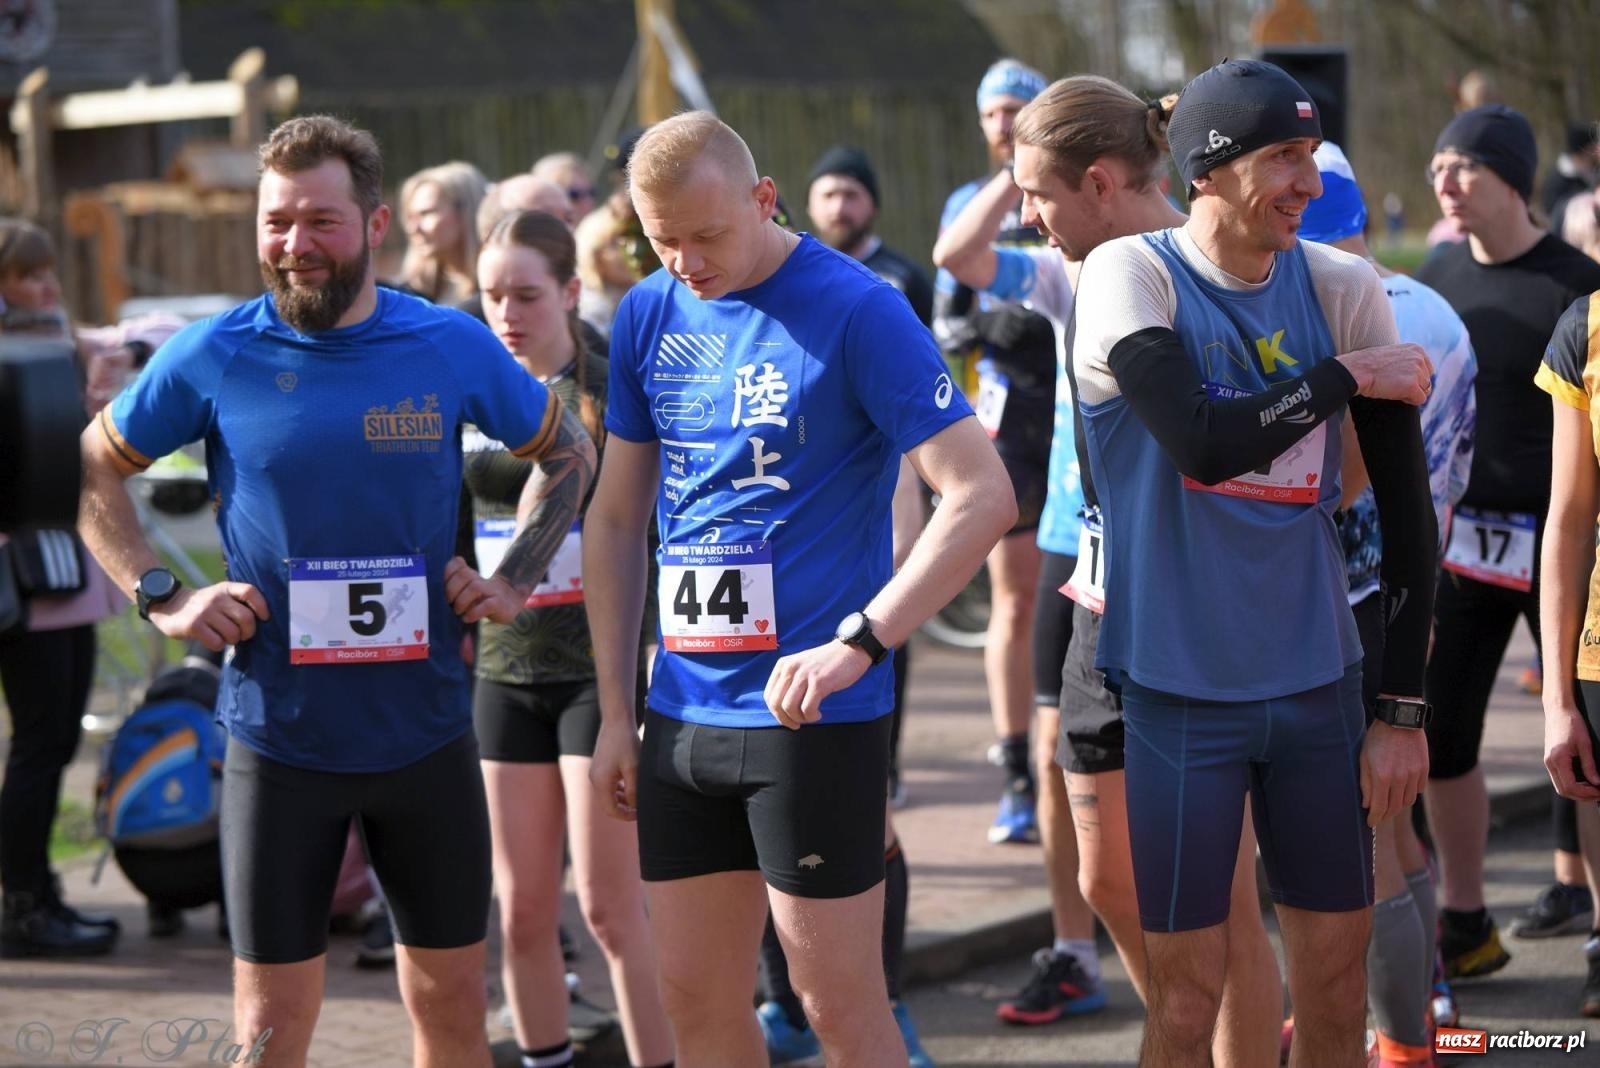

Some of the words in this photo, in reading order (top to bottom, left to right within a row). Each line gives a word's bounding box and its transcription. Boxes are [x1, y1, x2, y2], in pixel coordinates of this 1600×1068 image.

[1217, 387, 1233, 398] XII
[1259, 381, 1312, 427] Rogelli
[367, 416, 441, 437] SILESIAN
[731, 362, 790, 491] 陸上
[1224, 482, 1266, 496] Racibórz
[690, 544, 754, 555] TWARDZIELA
[1475, 527, 1512, 564] 17
[307, 561, 321, 570] XII
[323, 560, 348, 570] BIEG
[350, 558, 414, 569] TWARDZIELA
[673, 569, 749, 625] 44
[348, 582, 387, 636] 5
[682, 639, 716, 647] Racibórz
[723, 639, 743, 647] OSiR
[337, 650, 378, 659] Racibórz
